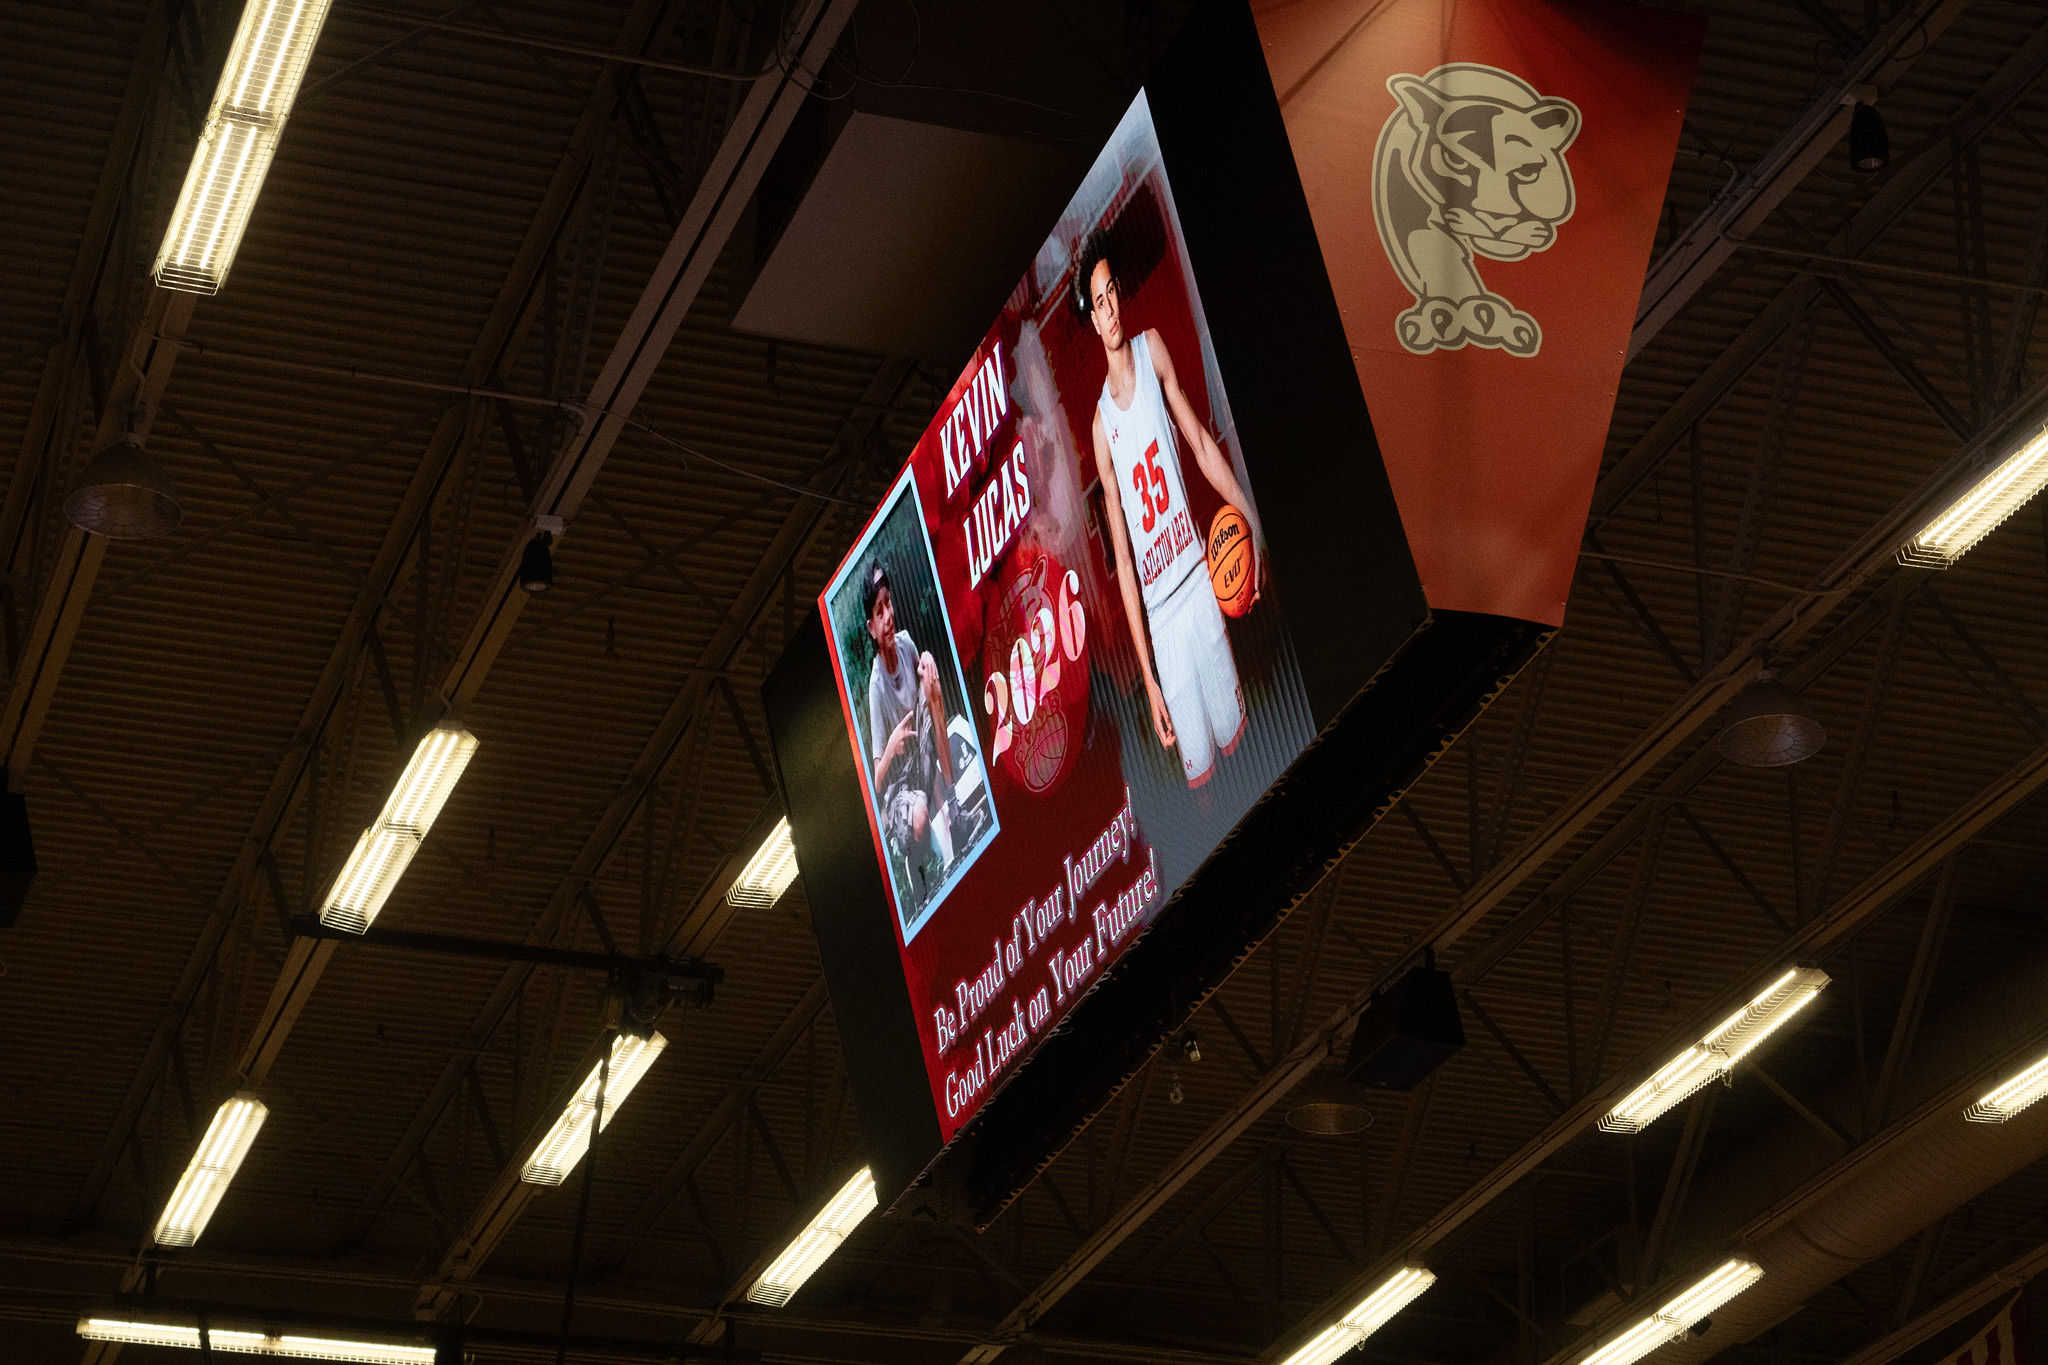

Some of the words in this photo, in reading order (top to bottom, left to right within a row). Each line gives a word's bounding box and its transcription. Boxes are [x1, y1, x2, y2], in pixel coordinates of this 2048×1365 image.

[939, 341, 1008, 499] KEVIN
[1132, 437, 1170, 534] 35
[963, 441, 1031, 591] LUCAS
[1171, 507, 1194, 557] AREA
[1210, 523, 1240, 562] Wilson
[984, 569, 1086, 767] 2026
[933, 1006, 957, 1055] Be
[955, 937, 1004, 1030] Proud
[1006, 919, 1022, 973] of
[1020, 899, 1063, 952] Your
[1063, 786, 1134, 919] Journey!
[945, 1043, 986, 1118] Good
[984, 999, 1027, 1076] Luck
[1029, 987, 1051, 1029] on
[1048, 950, 1092, 1003] Your
[1092, 847, 1158, 957] Future!
